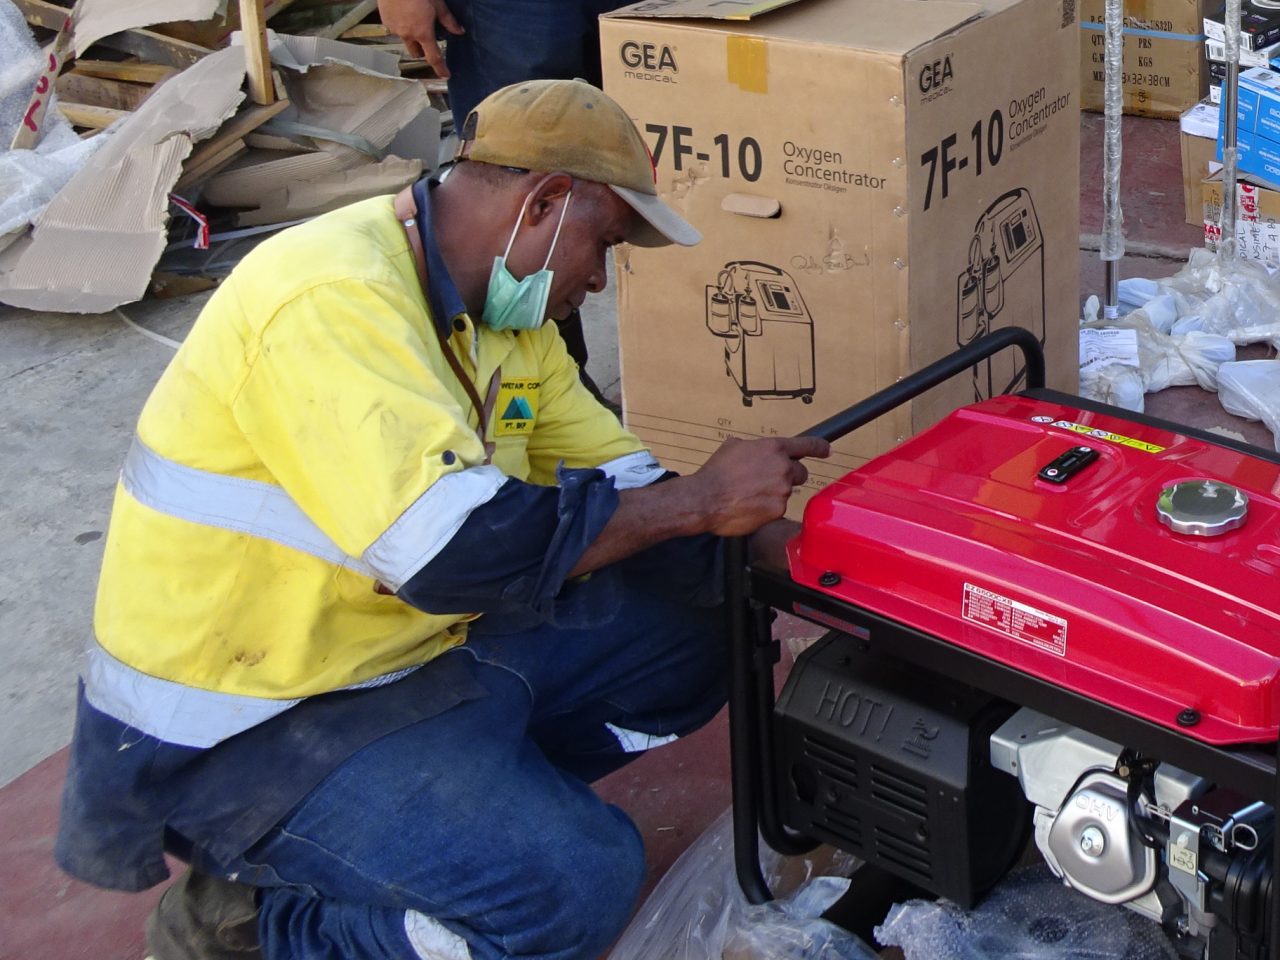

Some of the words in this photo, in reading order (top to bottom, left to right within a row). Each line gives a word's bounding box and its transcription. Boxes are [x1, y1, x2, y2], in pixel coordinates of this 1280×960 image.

[620, 40, 679, 74] GEA
[1138, 38, 1152, 49] PRS
[919, 54, 953, 94] GEA
[1138, 56, 1153, 68] KGS
[1008, 86, 1046, 118] Oxygen
[1008, 92, 1071, 140] Concentrator
[645, 123, 762, 183] 7F-10
[783, 141, 842, 166] Oxygen
[921, 109, 1004, 212] 7F-10
[783, 160, 886, 190] Concentrator
[815, 680, 895, 743] HOT!
[1076, 794, 1119, 822] OHV
